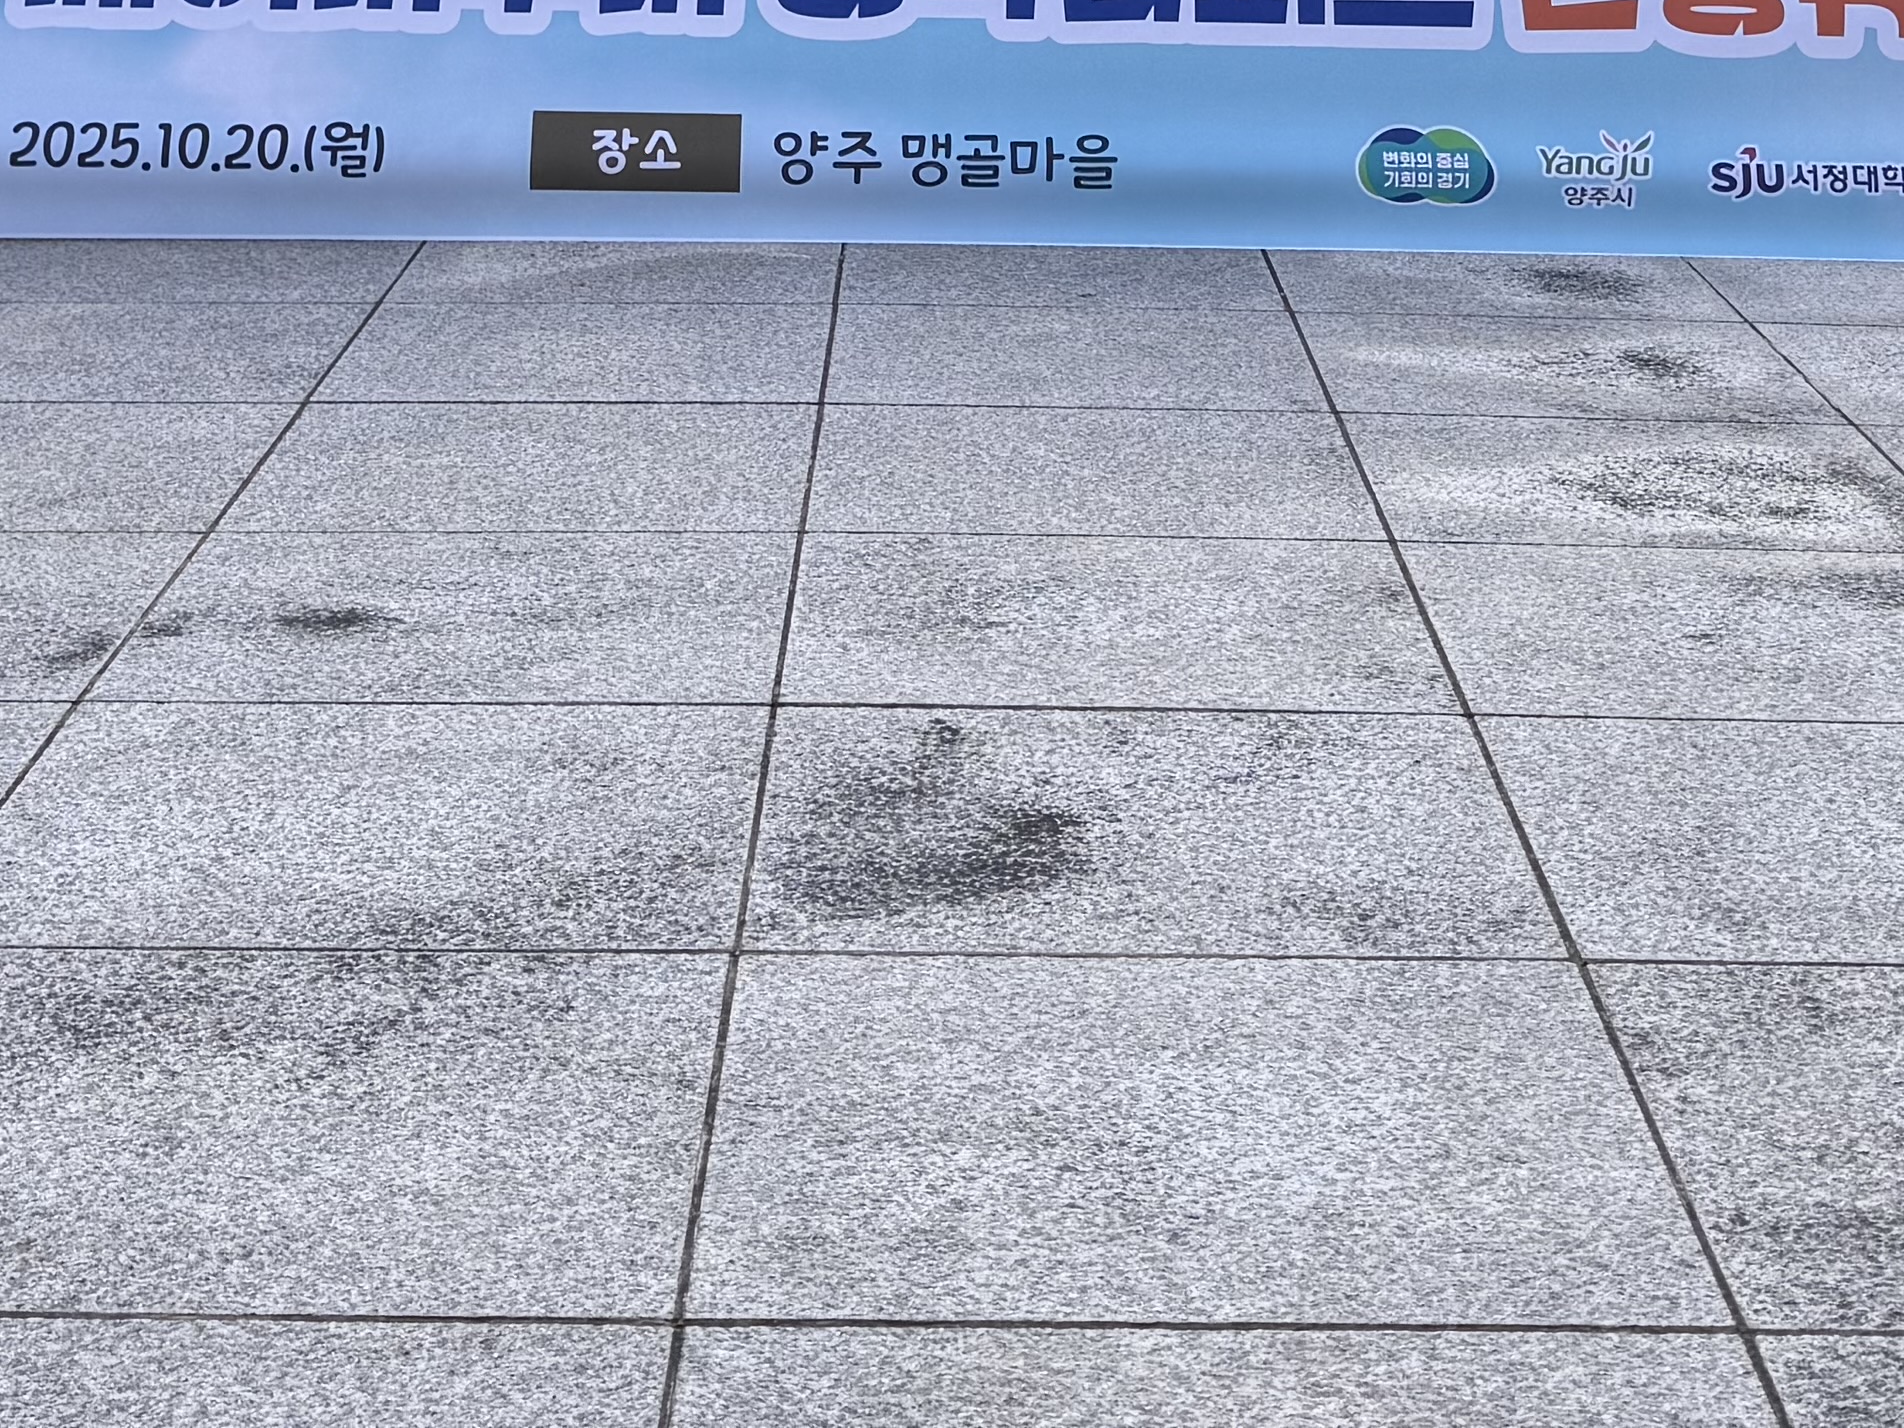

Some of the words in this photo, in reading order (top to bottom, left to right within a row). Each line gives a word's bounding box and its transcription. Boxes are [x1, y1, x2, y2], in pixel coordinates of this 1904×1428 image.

[8, 120, 386, 179] 2025.10.20.(월)
[592, 127, 683, 176] 장소
[773, 130, 884, 186] 양주
[901, 133, 1120, 190] 맹골마을
[1382, 150, 1433, 170] 변화의
[1435, 150, 1470, 170] 중심
[1383, 170, 1433, 190] 기회의
[1435, 170, 1470, 190] 경기
[1563, 185, 1634, 208] 양주시
